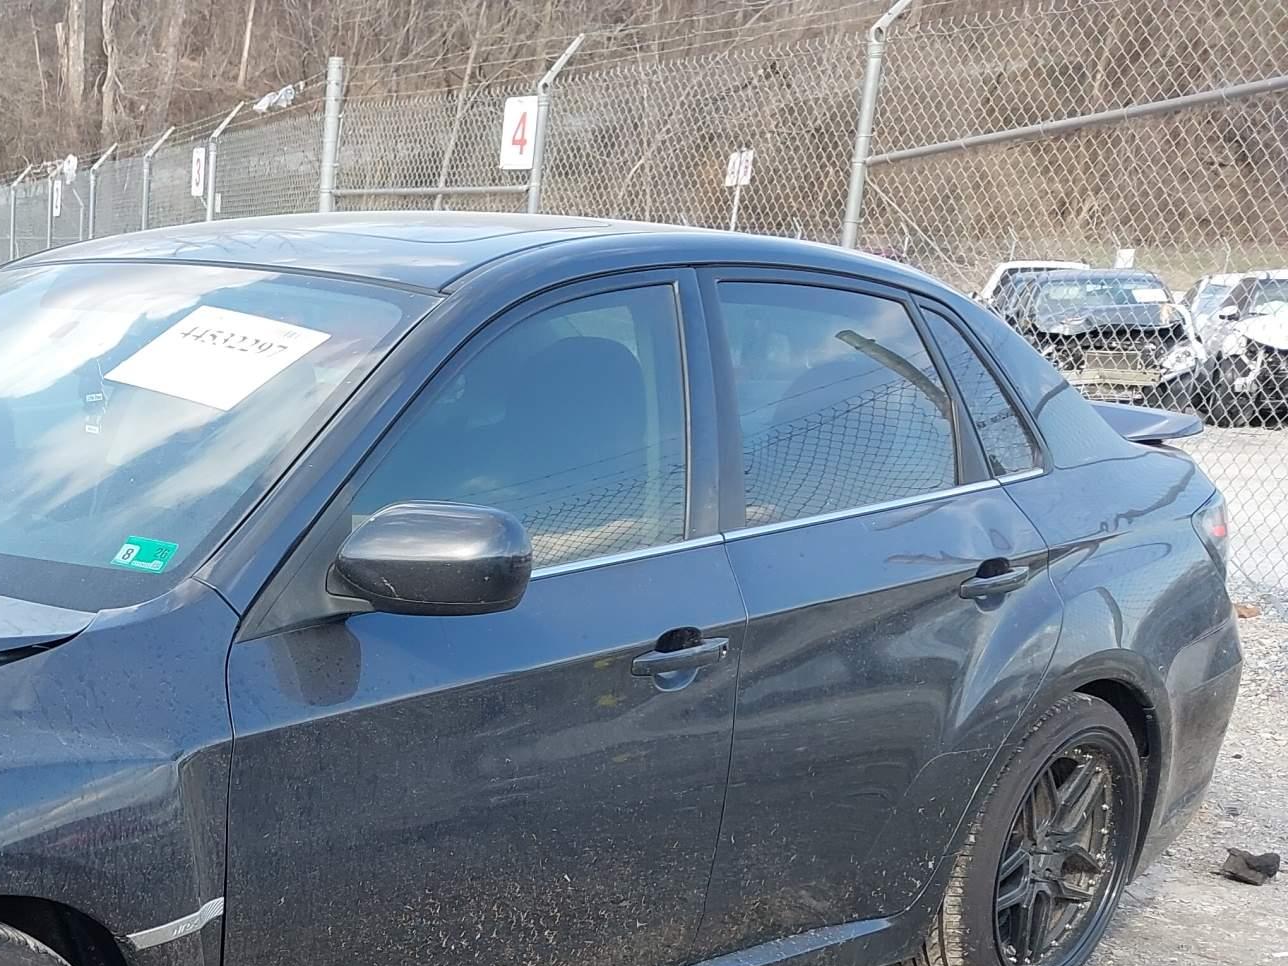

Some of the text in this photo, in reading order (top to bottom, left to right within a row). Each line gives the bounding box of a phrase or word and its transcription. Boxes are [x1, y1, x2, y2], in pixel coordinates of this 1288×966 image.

[512, 111, 527, 155] 4
[194, 158, 202, 187] 3
[121, 548, 134, 560] 8
